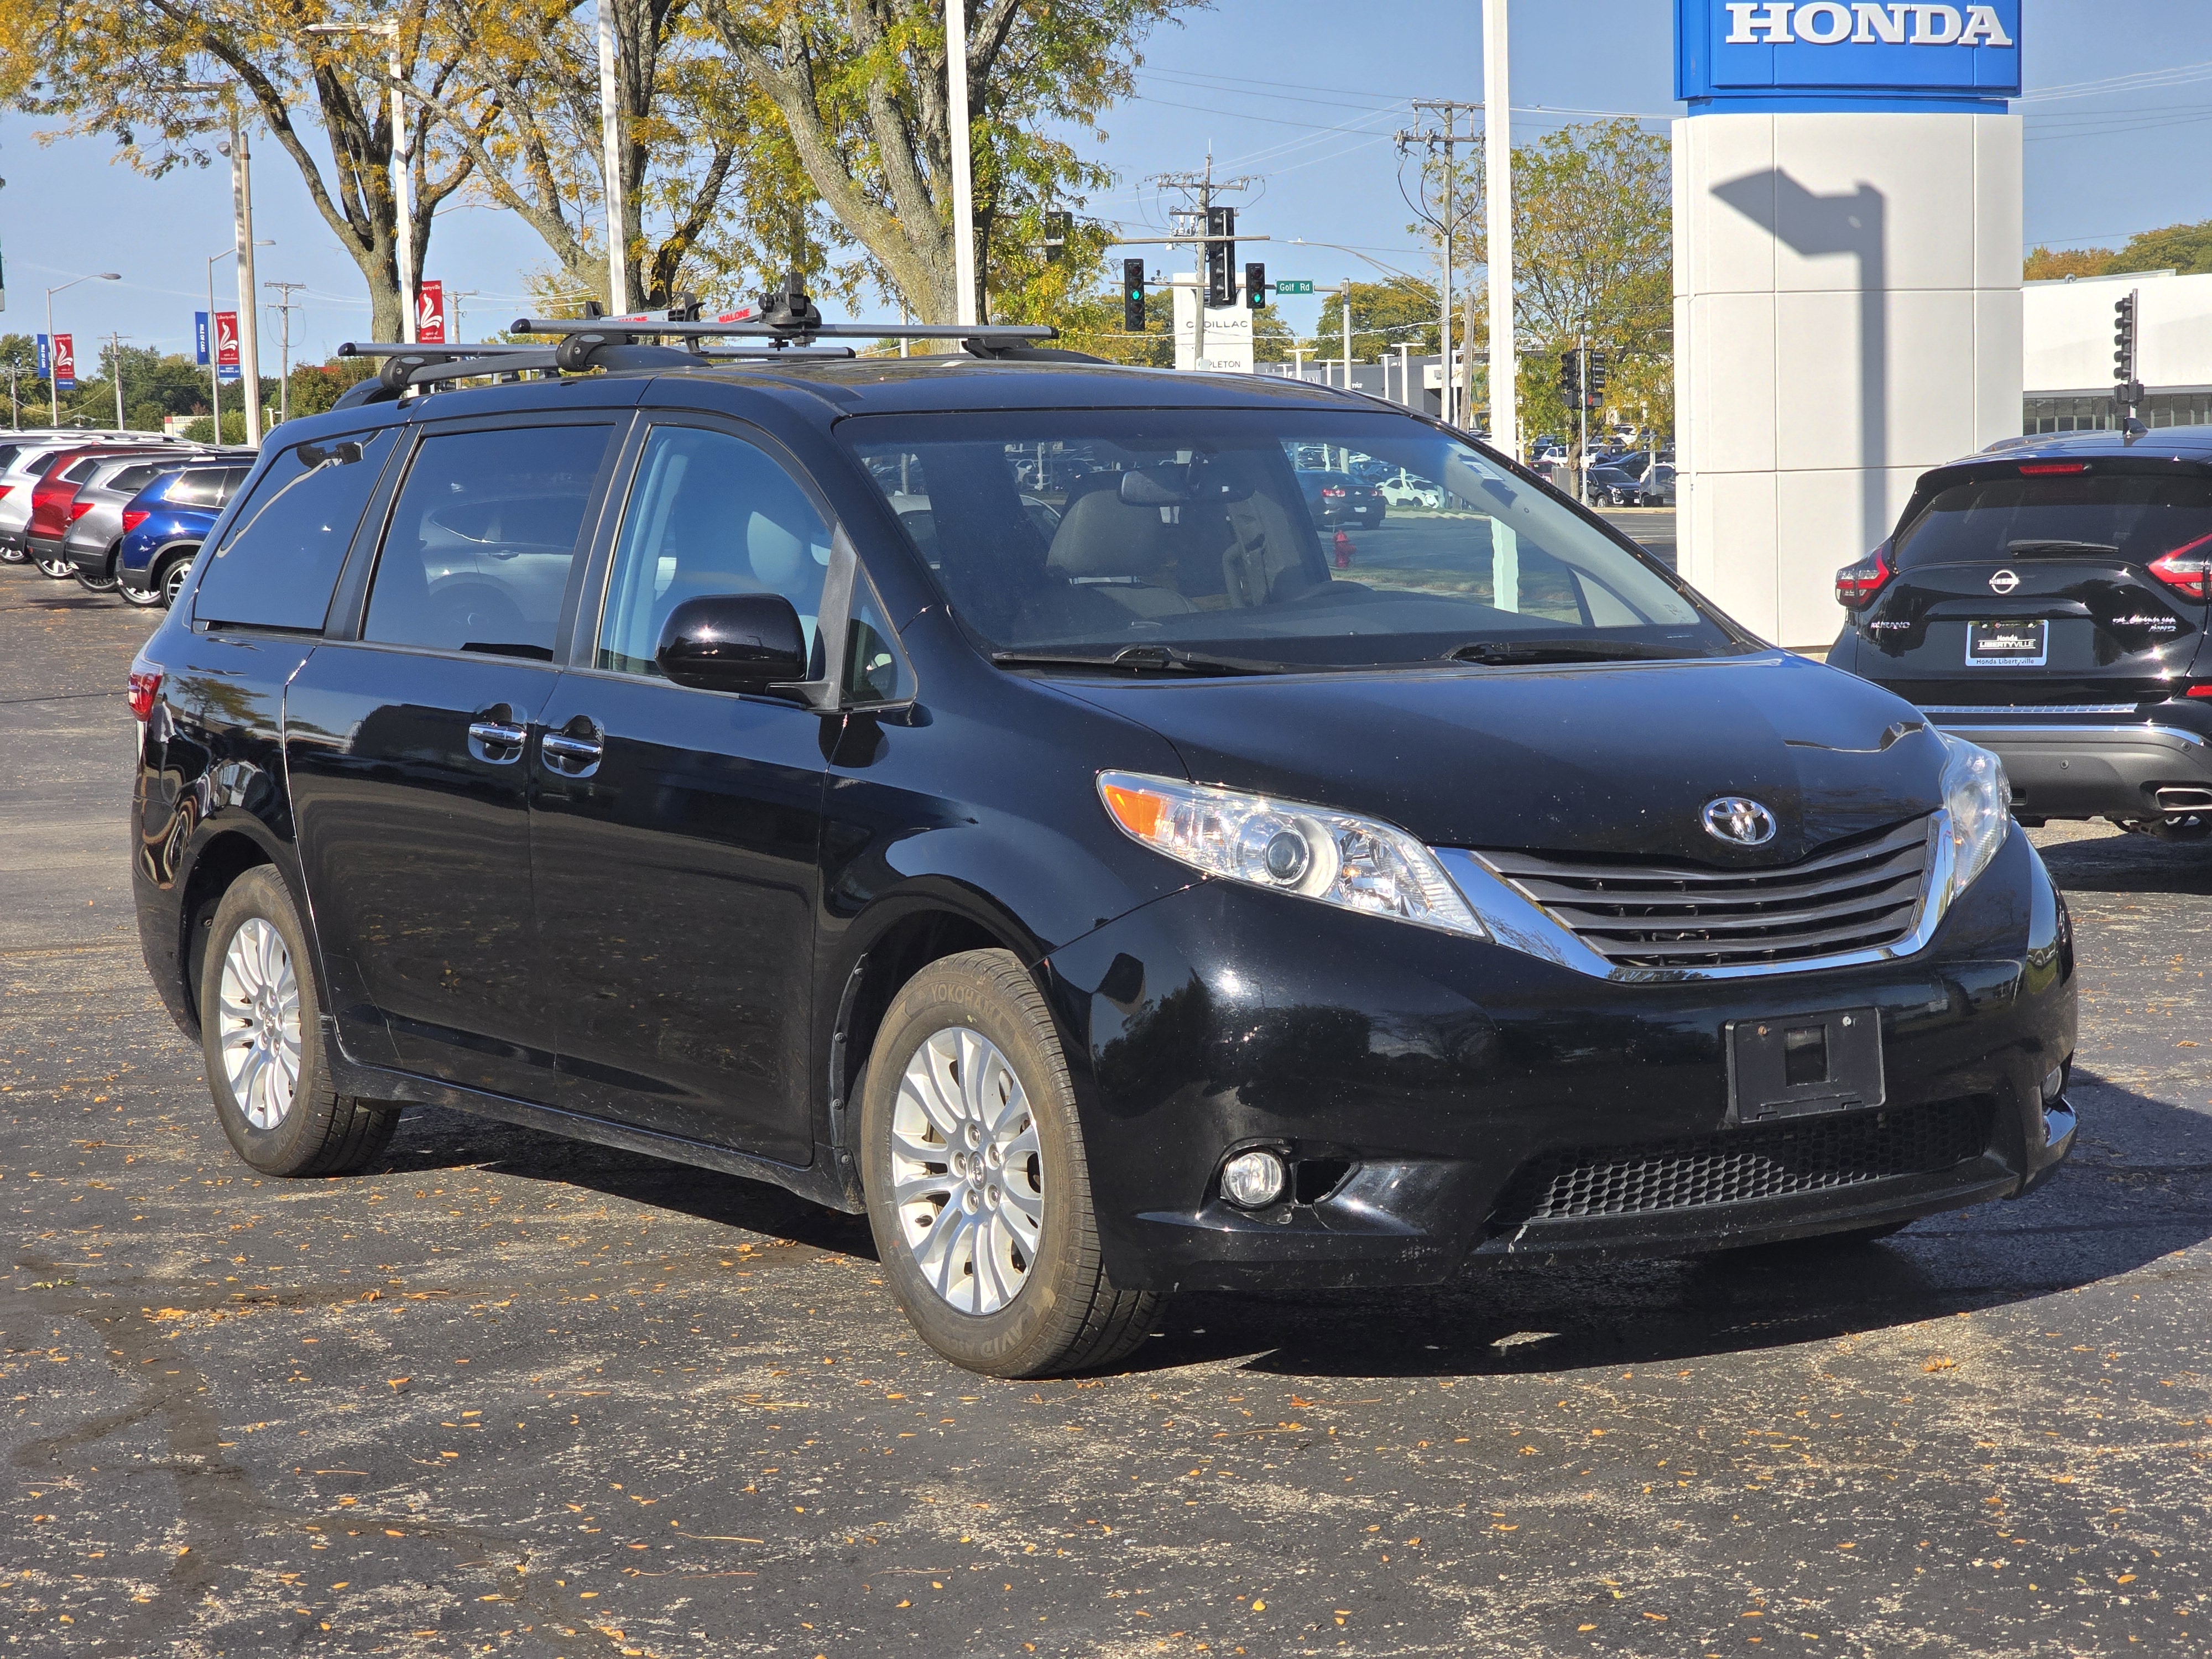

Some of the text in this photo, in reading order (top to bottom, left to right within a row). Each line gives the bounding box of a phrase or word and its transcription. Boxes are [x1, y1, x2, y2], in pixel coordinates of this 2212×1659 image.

[1725, 2, 2012, 45] HONDA
[1280, 283, 1310, 291] Golf Rd
[718, 309, 750, 324] MALONE
